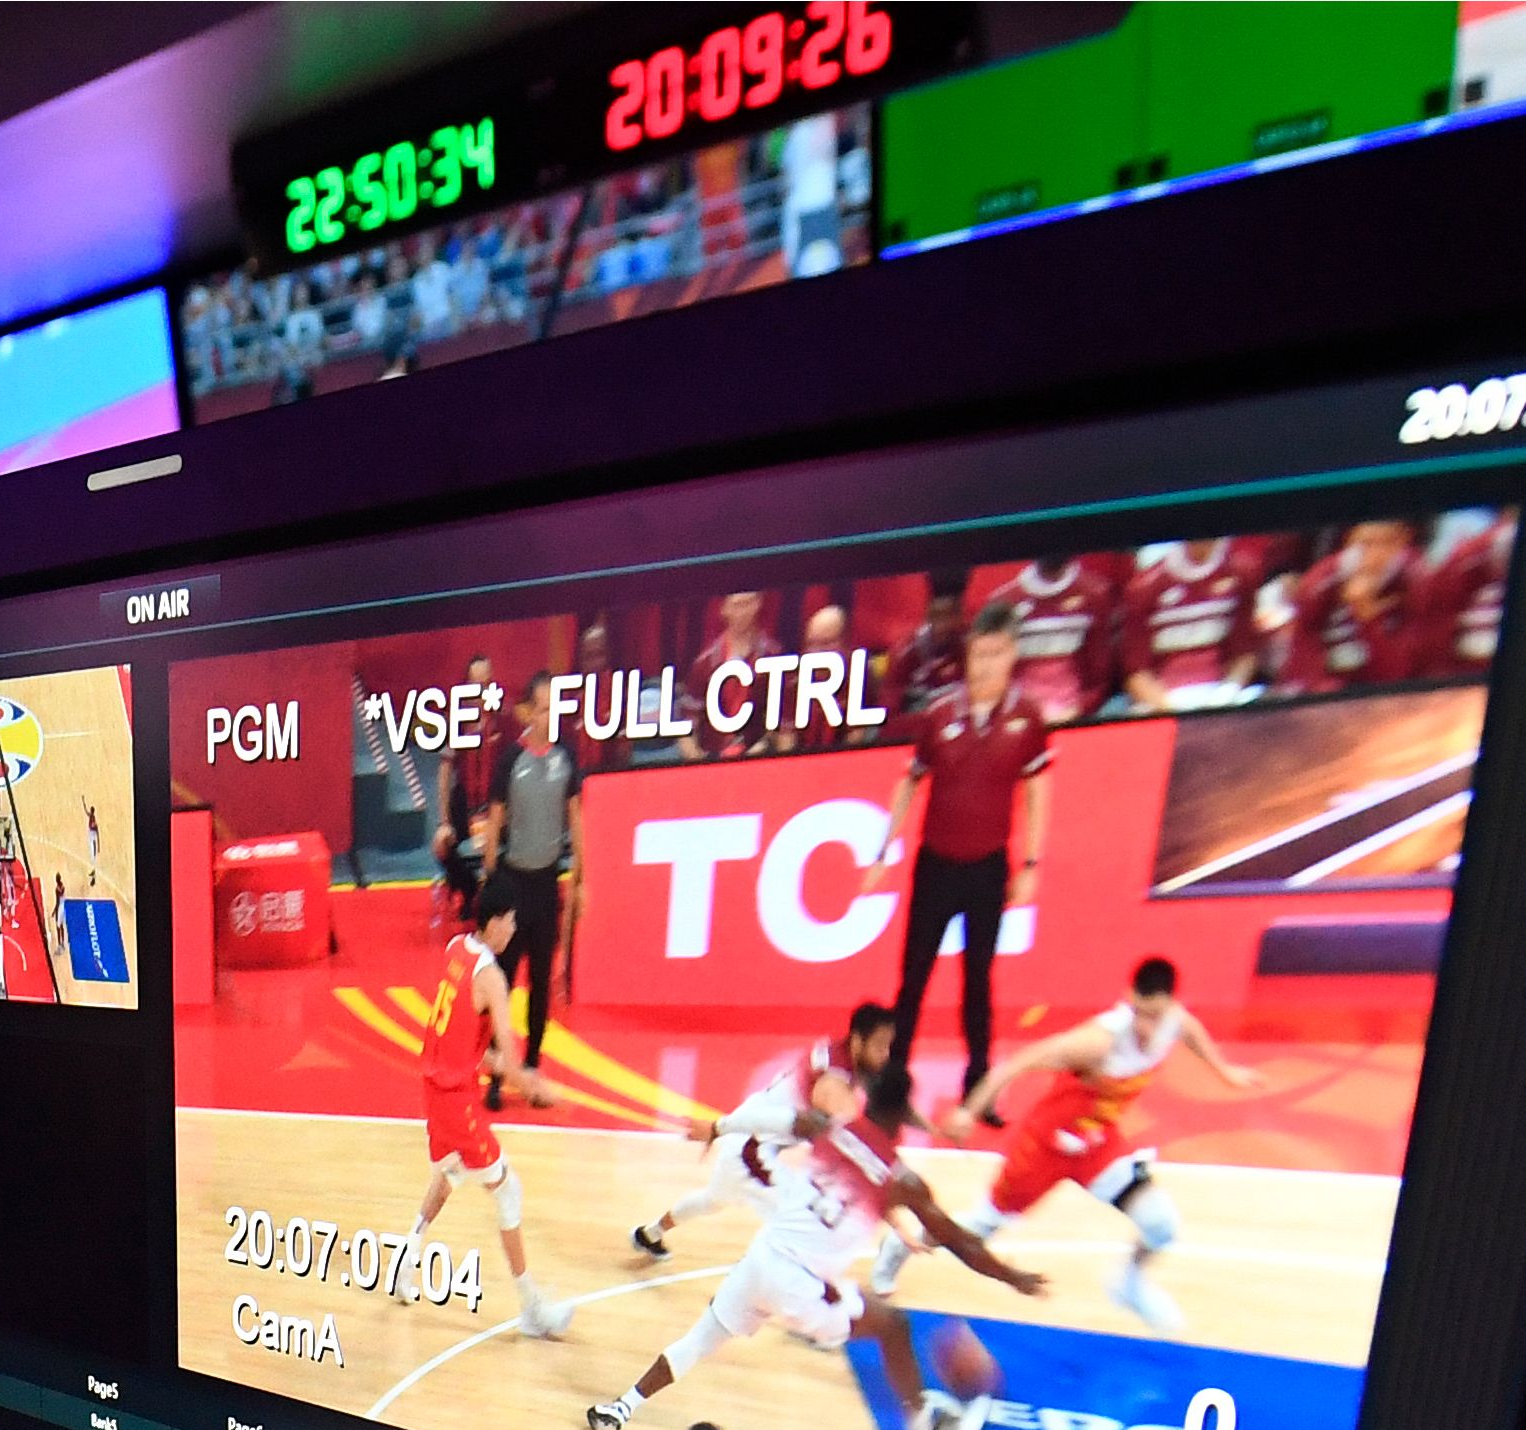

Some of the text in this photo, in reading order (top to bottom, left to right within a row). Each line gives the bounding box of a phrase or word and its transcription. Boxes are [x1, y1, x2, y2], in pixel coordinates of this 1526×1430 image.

[606, 0, 891, 150] 20:09:26
[284, 116, 495, 253] 22:50:34
[126, 588, 189, 623] ON AIR
[205, 700, 300, 764] PGM
[548, 667, 692, 744] FULL
[706, 648, 887, 734] CTRL
[223, 1206, 482, 1313] 20:07:07:04
[231, 1294, 344, 1367] CamA
[88, 1376, 118, 1399] Page5
